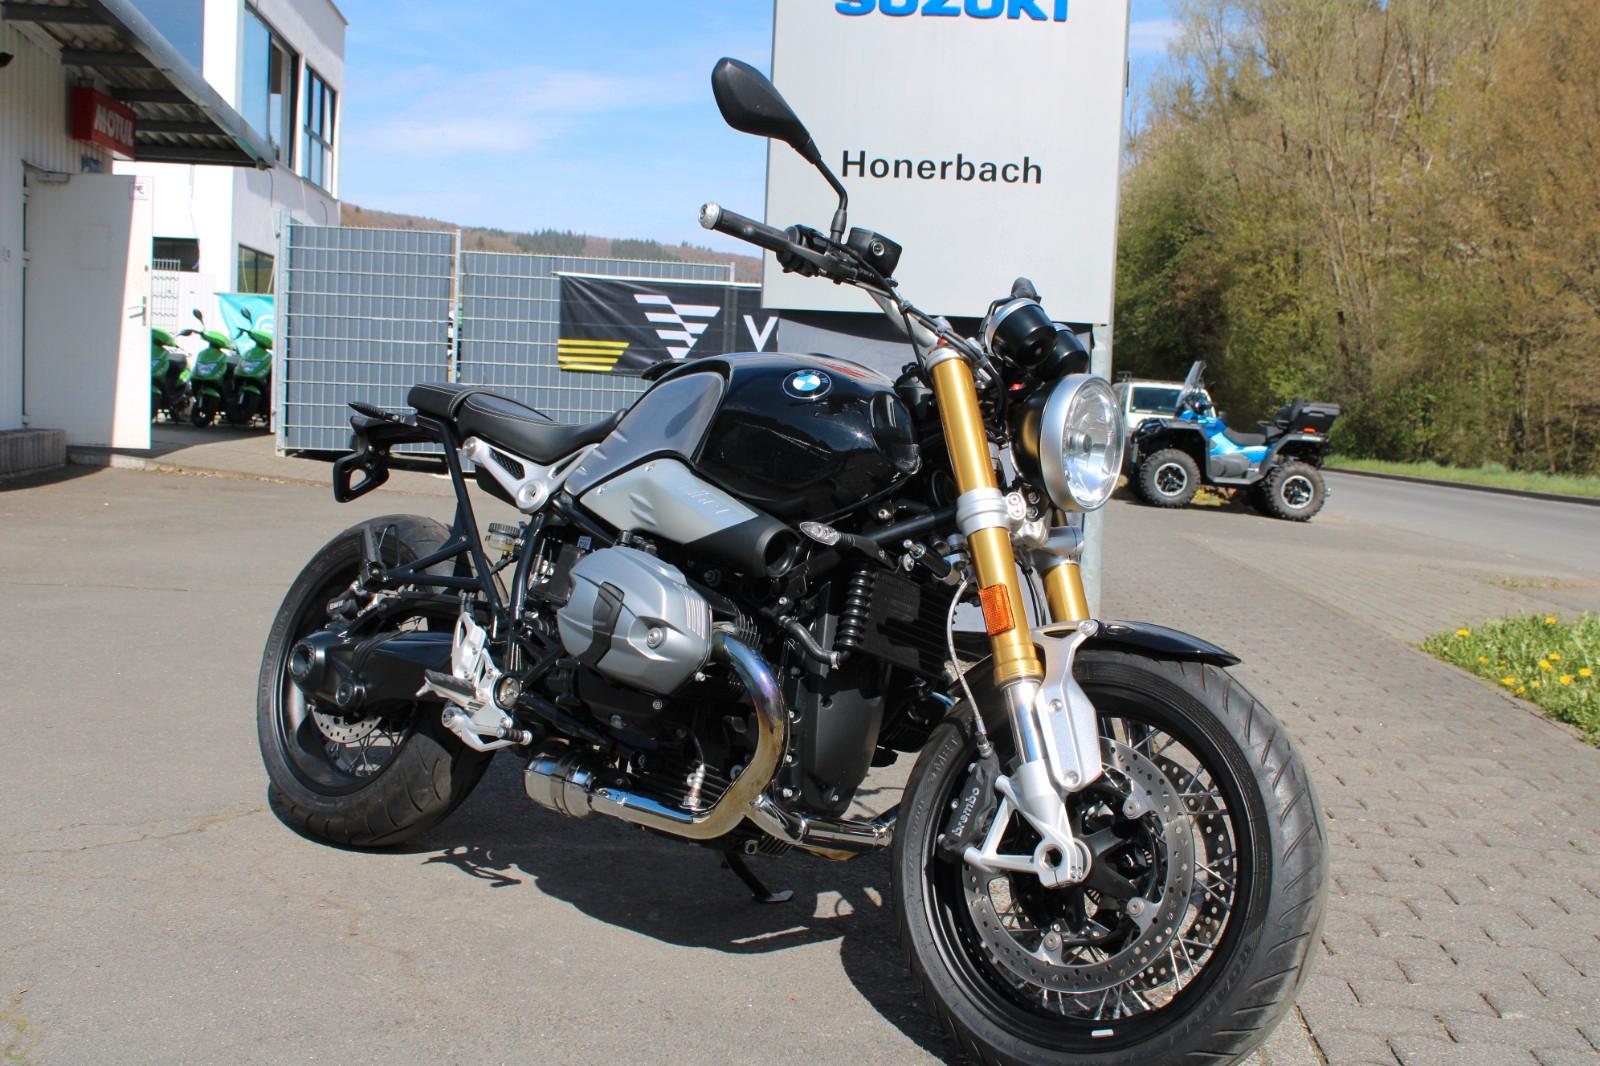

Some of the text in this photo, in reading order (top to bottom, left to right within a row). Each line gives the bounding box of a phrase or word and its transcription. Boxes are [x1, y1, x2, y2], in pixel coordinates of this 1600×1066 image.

[94, 102, 134, 148] MOTUL
[842, 150, 1042, 184] Honerbach
[951, 787, 980, 837] brembo
